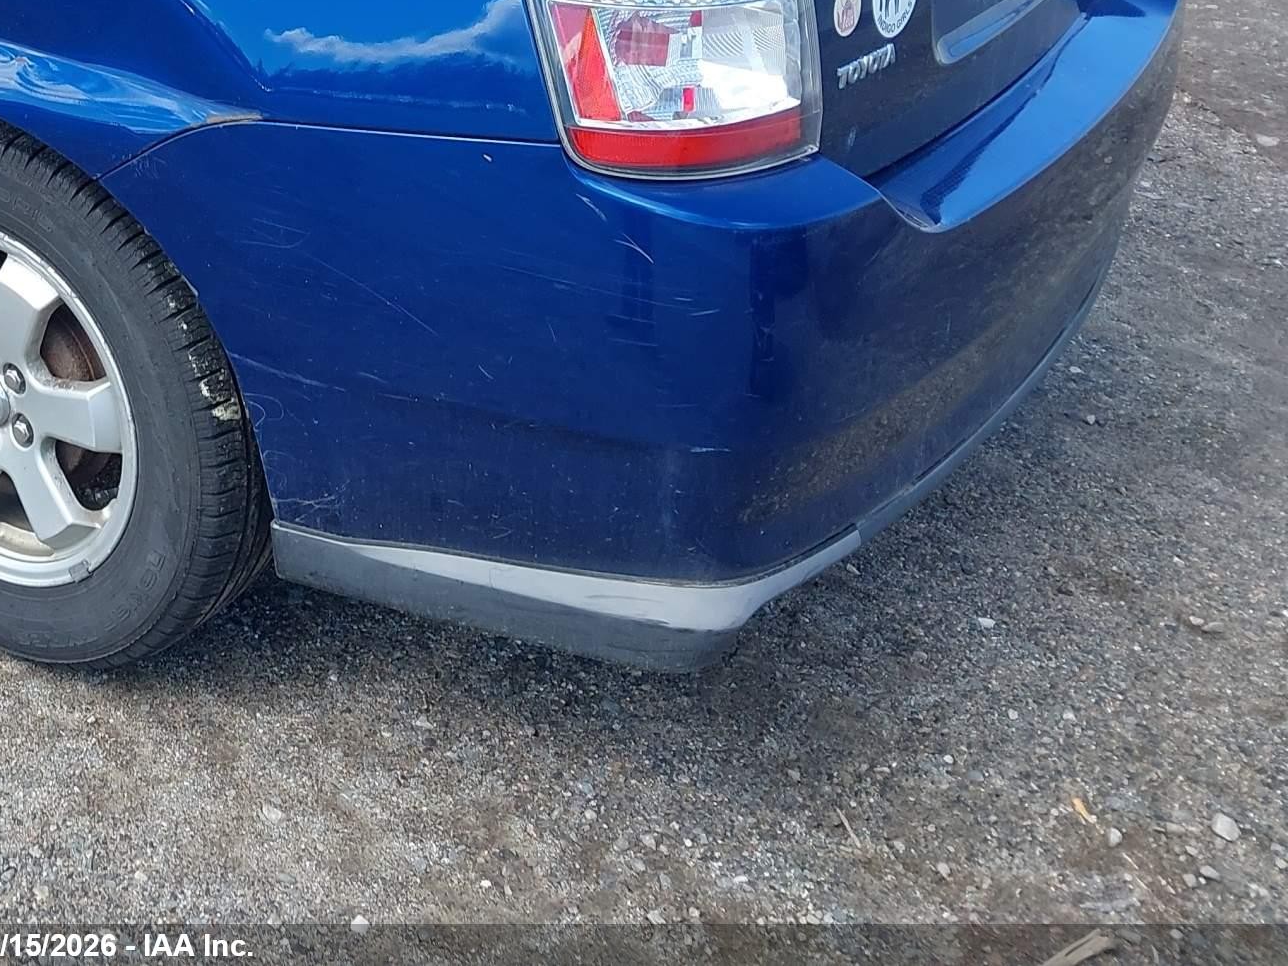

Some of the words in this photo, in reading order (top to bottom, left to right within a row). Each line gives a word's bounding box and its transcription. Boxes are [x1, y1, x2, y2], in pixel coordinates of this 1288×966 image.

[877, 14, 896, 33] INDIGO
[896, 1, 913, 29] GIRLS
[837, 43, 896, 89] TOYOTA
